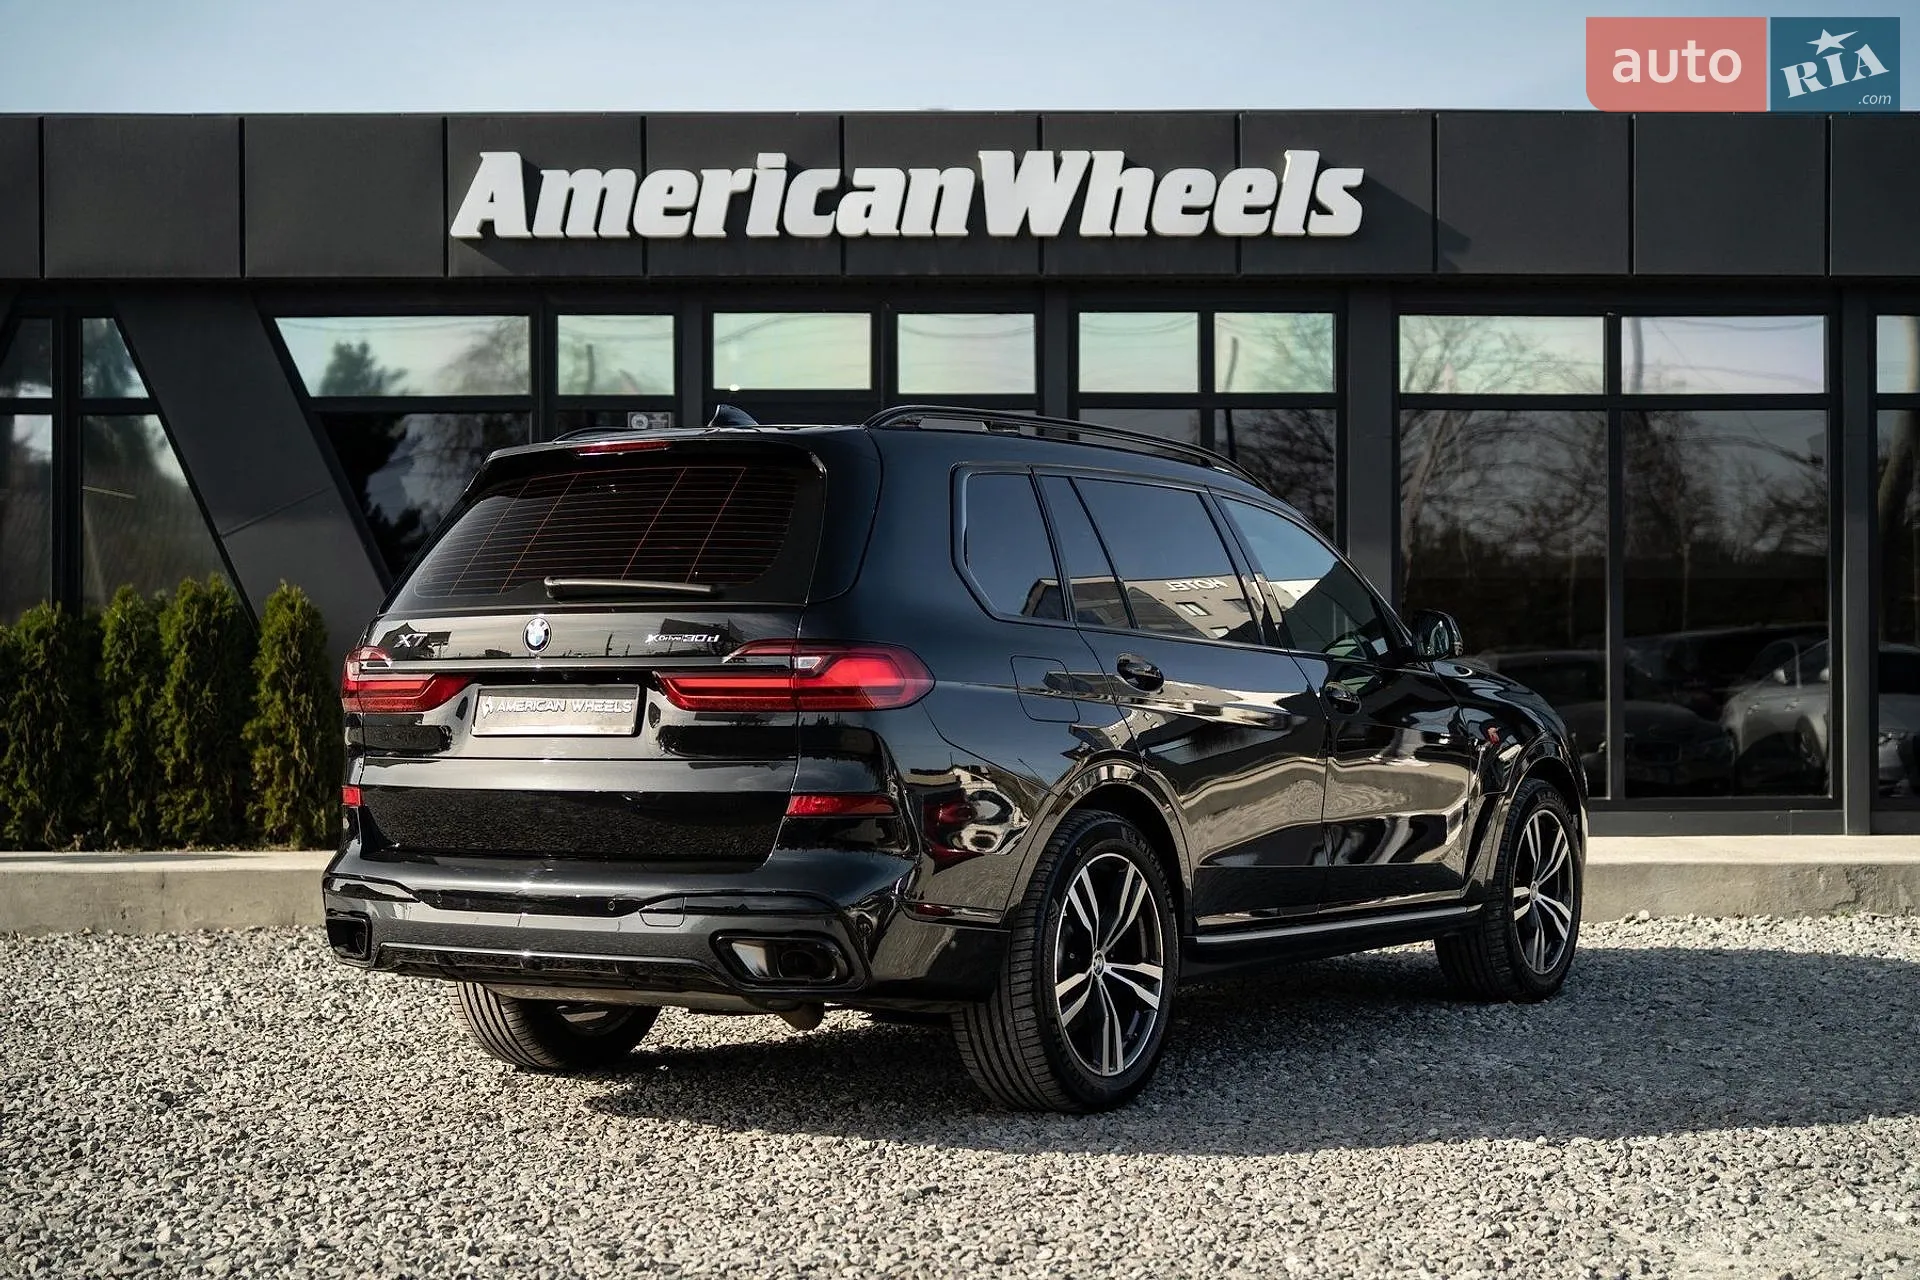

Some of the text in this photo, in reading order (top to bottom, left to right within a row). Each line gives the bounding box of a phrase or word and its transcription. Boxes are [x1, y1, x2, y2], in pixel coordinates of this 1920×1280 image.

[394, 633, 428, 648] X7
[496, 700, 633, 714] AMERICAN WHEELS
